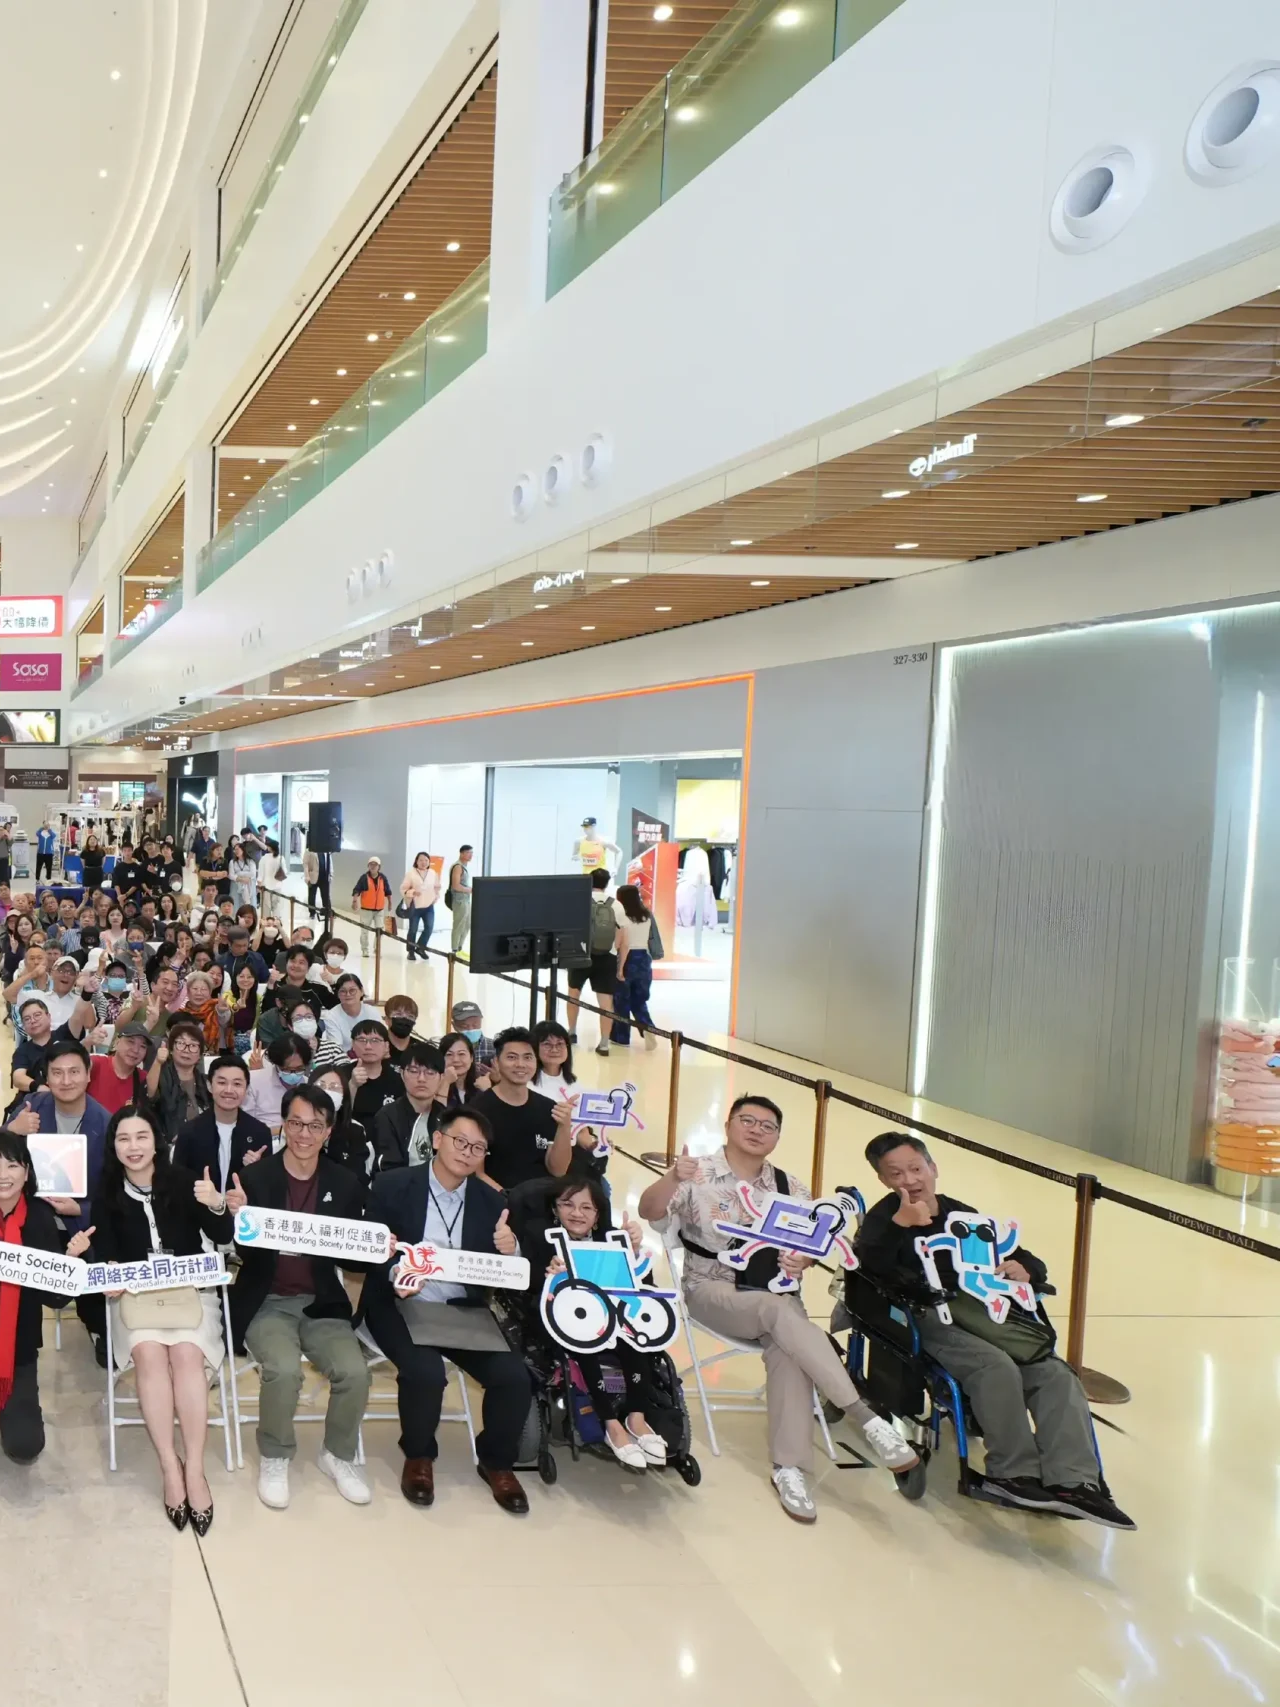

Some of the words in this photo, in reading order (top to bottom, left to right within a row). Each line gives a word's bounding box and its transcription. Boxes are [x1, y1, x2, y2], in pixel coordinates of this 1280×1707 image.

[893, 653, 928, 666] 327-330
[264, 1217, 387, 1245] 香港聾人福利促進會
[264, 1231, 277, 1240] The
[278, 1233, 297, 1245] Hong
[299, 1235, 317, 1247] Kong
[319, 1238, 344, 1250] Society
[345, 1242, 355, 1250] for
[356, 1244, 368, 1252] the
[370, 1246, 387, 1254] Deaf
[1168, 1211, 1225, 1240] HOPEWELL
[1226, 1232, 1258, 1251] MALL
[25, 1253, 77, 1278] Society
[87, 1255, 219, 1287] 網絡安全同行計劃
[469, 1266, 485, 1275] Hong
[486, 1268, 502, 1276] Kong
[502, 1270, 524, 1279] Society
[32, 1272, 80, 1292] Chapter
[128, 1278, 165, 1290] CyberSafe
[189, 1273, 220, 1283] Program
